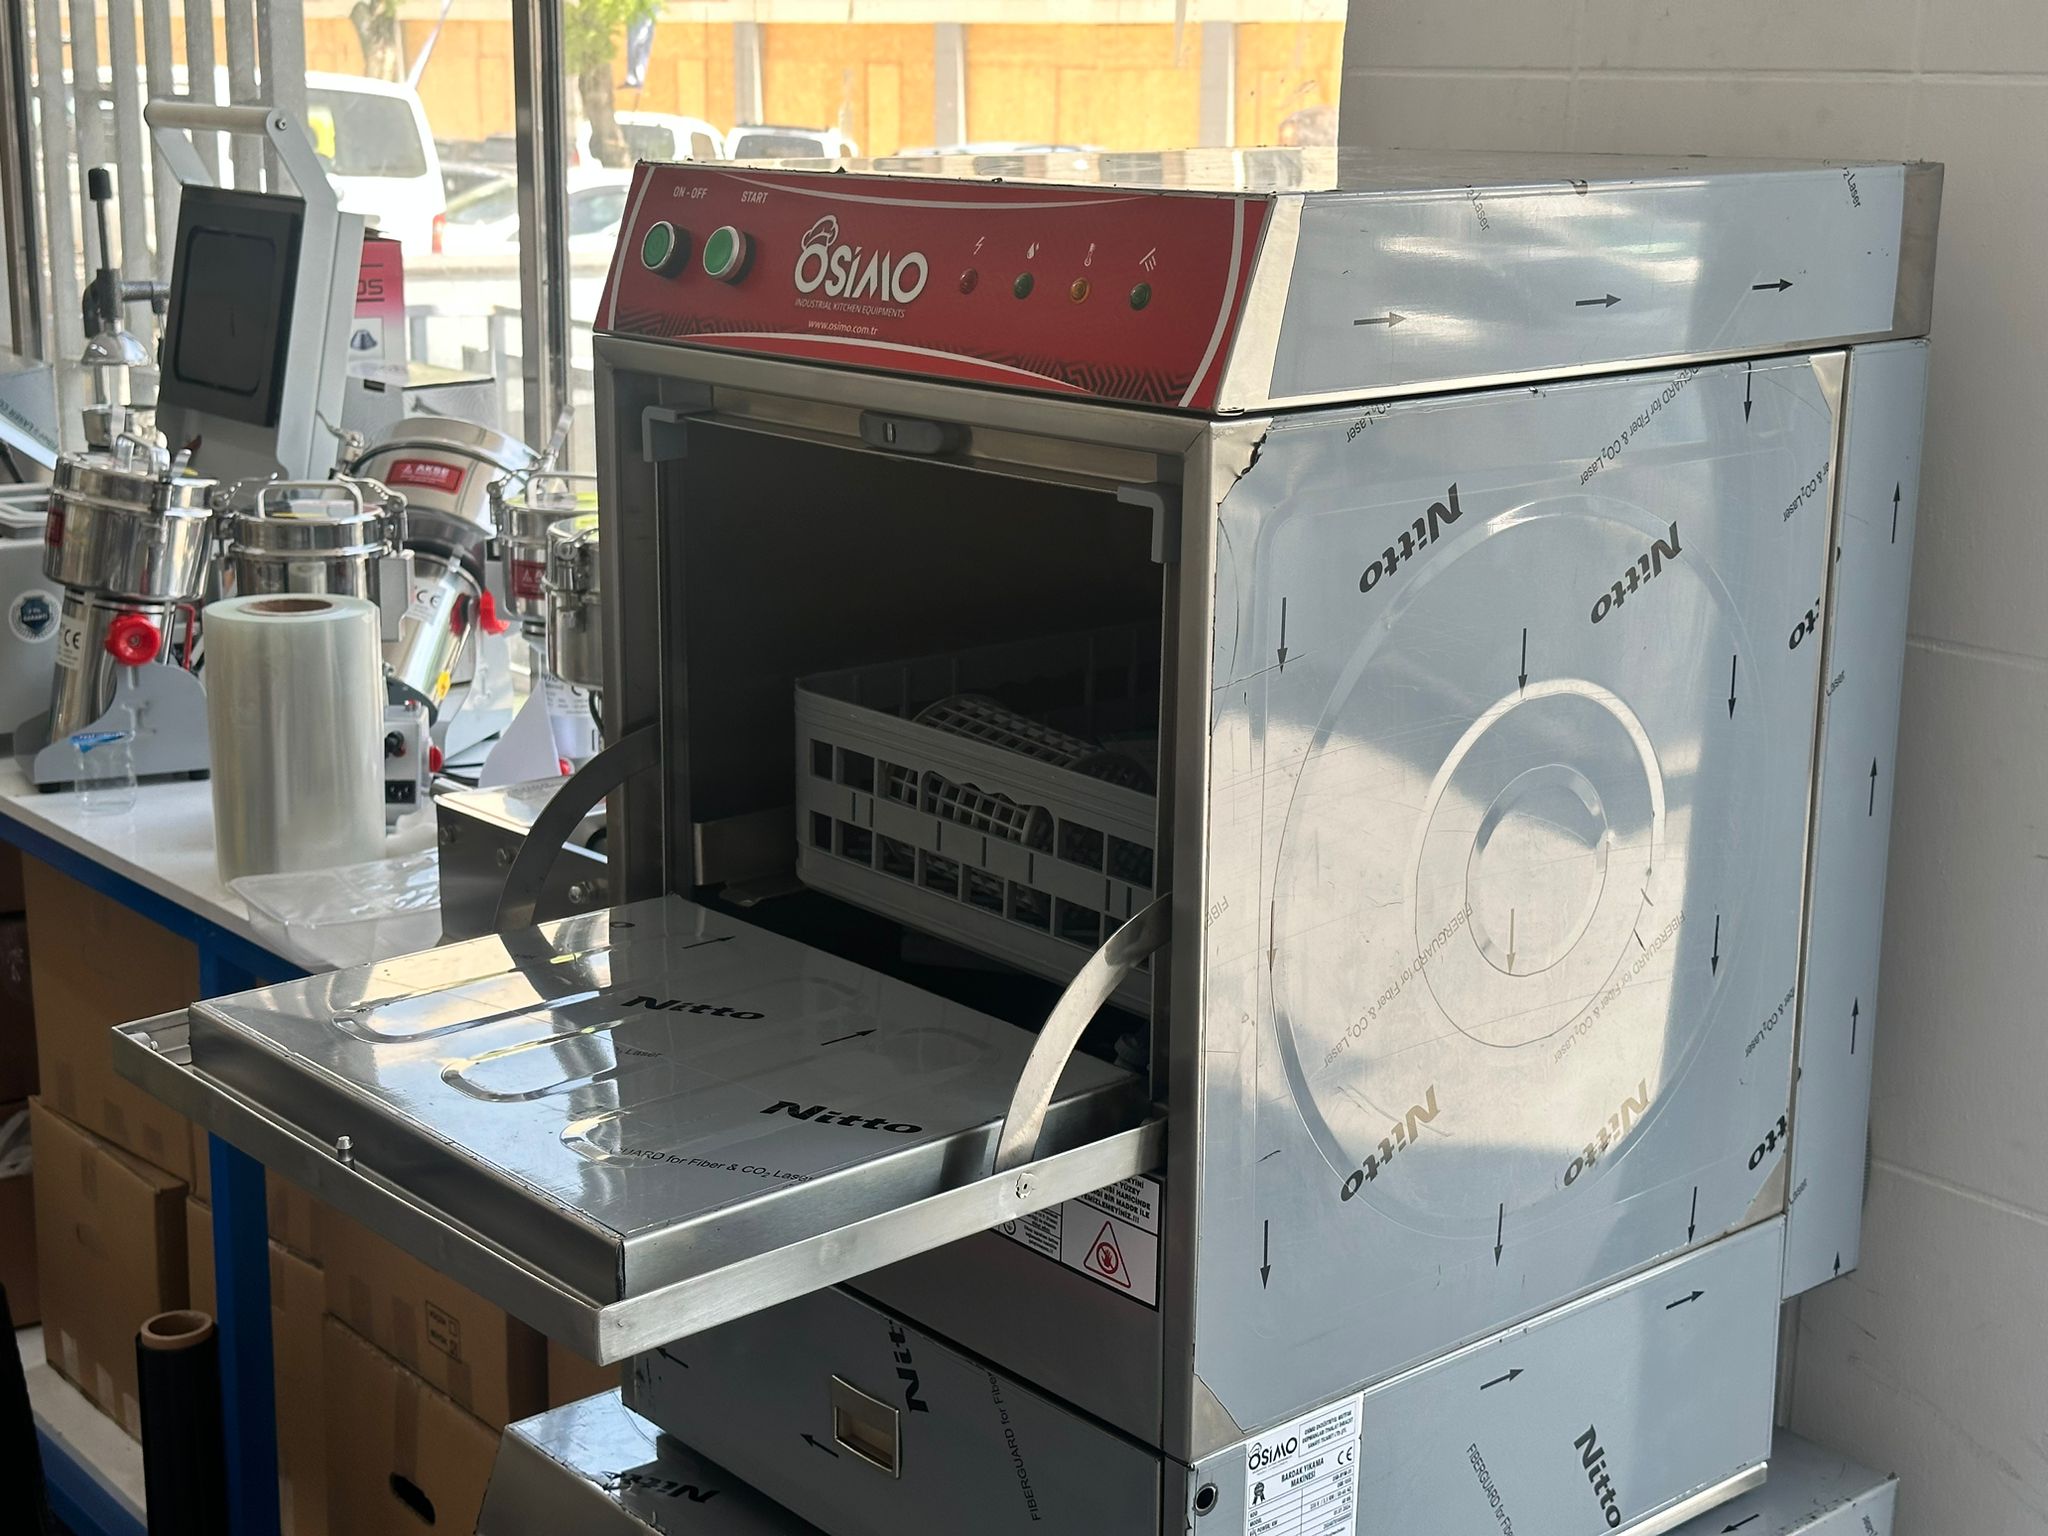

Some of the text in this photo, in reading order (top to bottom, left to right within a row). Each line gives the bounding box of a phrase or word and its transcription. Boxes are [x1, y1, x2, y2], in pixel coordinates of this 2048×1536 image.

[741, 190, 768, 204] START
[1848, 173, 1860, 208] Laser
[1472, 191, 1490, 232] Laser
[794, 298, 906, 318] INDUSTRIAL KITCHEN EQUIPMENTS
[808, 320, 878, 335] www.osimo.com.tr
[1650, 398, 1662, 416] for
[1346, 411, 1374, 443] Laser
[1630, 409, 1651, 436] Fiber
[1620, 431, 1628, 445] &
[1580, 456, 1604, 486] Laser
[1782, 495, 1802, 522] Laser
[1359, 482, 1463, 593] Nitto
[1591, 520, 1682, 624] Nitto
[1413, 902, 1473, 972] FIBERGUARD
[1632, 910, 1686, 975] FIBERGUARD
[1400, 966, 1413, 986] for
[1620, 970, 1632, 990] for
[621, 996, 765, 1020] Nitto
[1377, 981, 1401, 1011] Fiber
[1600, 983, 1622, 1010] Fiber
[1368, 1006, 1376, 1020] &
[1592, 1006, 1600, 1019] &
[1323, 1036, 1350, 1068] Laser
[1553, 1034, 1577, 1064] Laser
[1744, 1030, 1766, 1058] Laser
[760, 1100, 923, 1134] Nitto
[1564, 1077, 1650, 1186] Nitto
[1340, 1084, 1440, 1202] Nitto
[665, 1154, 686, 1165] for
[687, 1158, 726, 1170] Fiber
[725, 1162, 738, 1172] &
[773, 1170, 814, 1183] Laser
[1000, 1408, 1010, 1424] for
[1004, 1428, 1041, 1522] FIBERGUARD
[1281, 1465, 1303, 1483] BARDAK
[1303, 1457, 1325, 1474] YIKAMA
[1466, 1442, 1501, 1508] FIBERGUARD
[1494, 1504, 1505, 1522] for
[1574, 1424, 1622, 1528] Nitto
